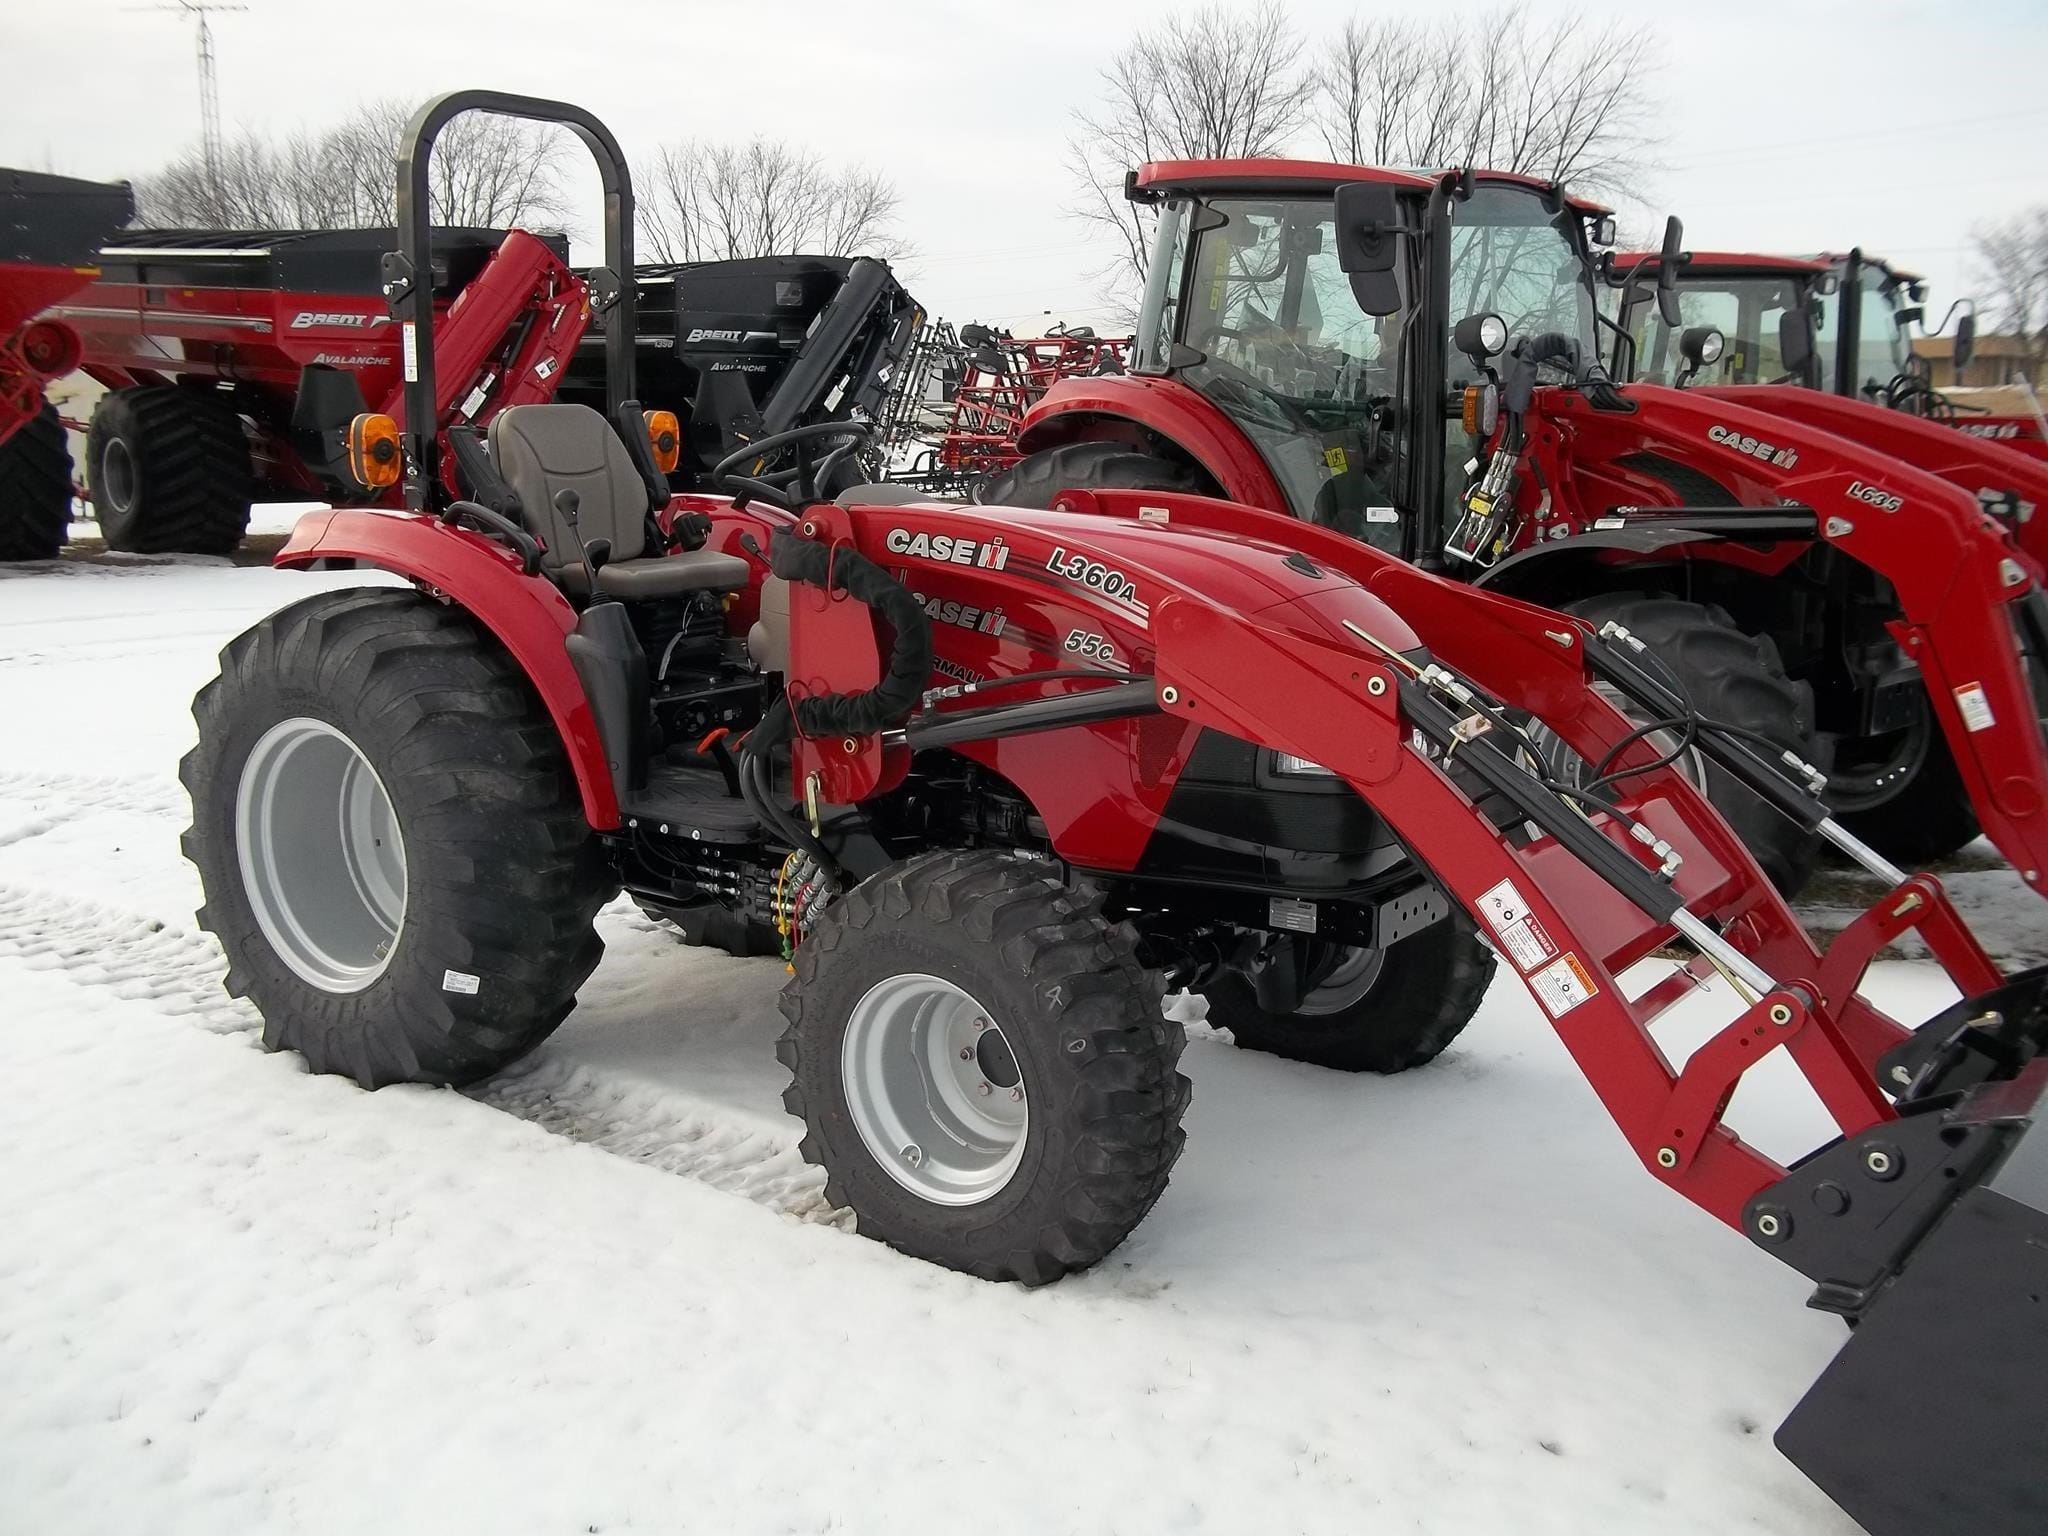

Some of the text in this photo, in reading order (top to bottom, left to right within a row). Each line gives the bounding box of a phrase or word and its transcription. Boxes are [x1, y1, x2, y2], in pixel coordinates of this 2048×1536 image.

[291, 312, 367, 328] BRENT
[686, 328, 742, 343] BRENT
[313, 352, 392, 365] AVALANCHE
[1708, 425, 1775, 461] CASE
[1845, 480, 1904, 513] L635
[886, 528, 977, 566] CASE
[1045, 546, 1137, 603] L360A
[1530, 923, 1553, 954] DANGER
